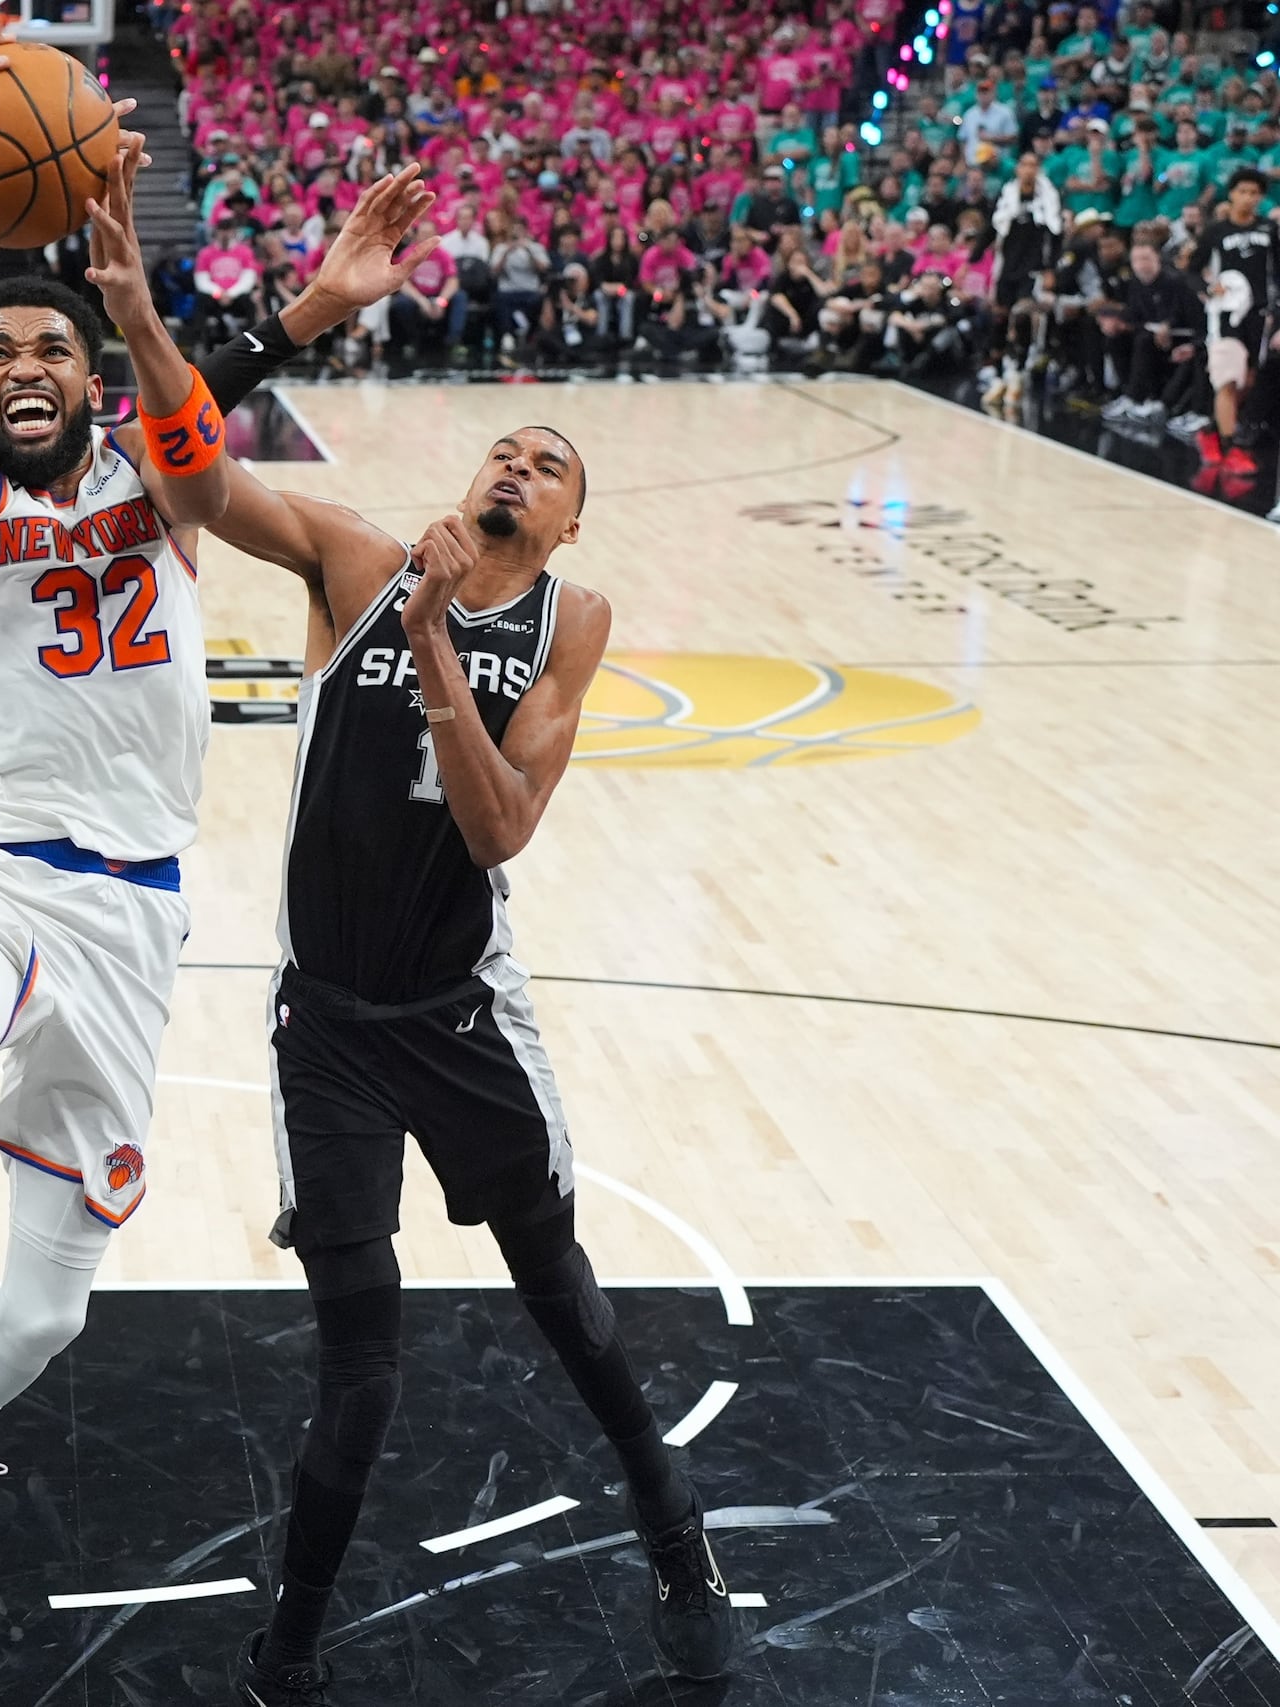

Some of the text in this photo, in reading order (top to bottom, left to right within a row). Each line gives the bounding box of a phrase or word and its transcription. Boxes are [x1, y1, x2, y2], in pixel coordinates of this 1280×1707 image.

[158, 401, 221, 467] 32
[31, 553, 172, 679] 32
[356, 647, 533, 702] SPRS
[408, 726, 446, 804] 1
